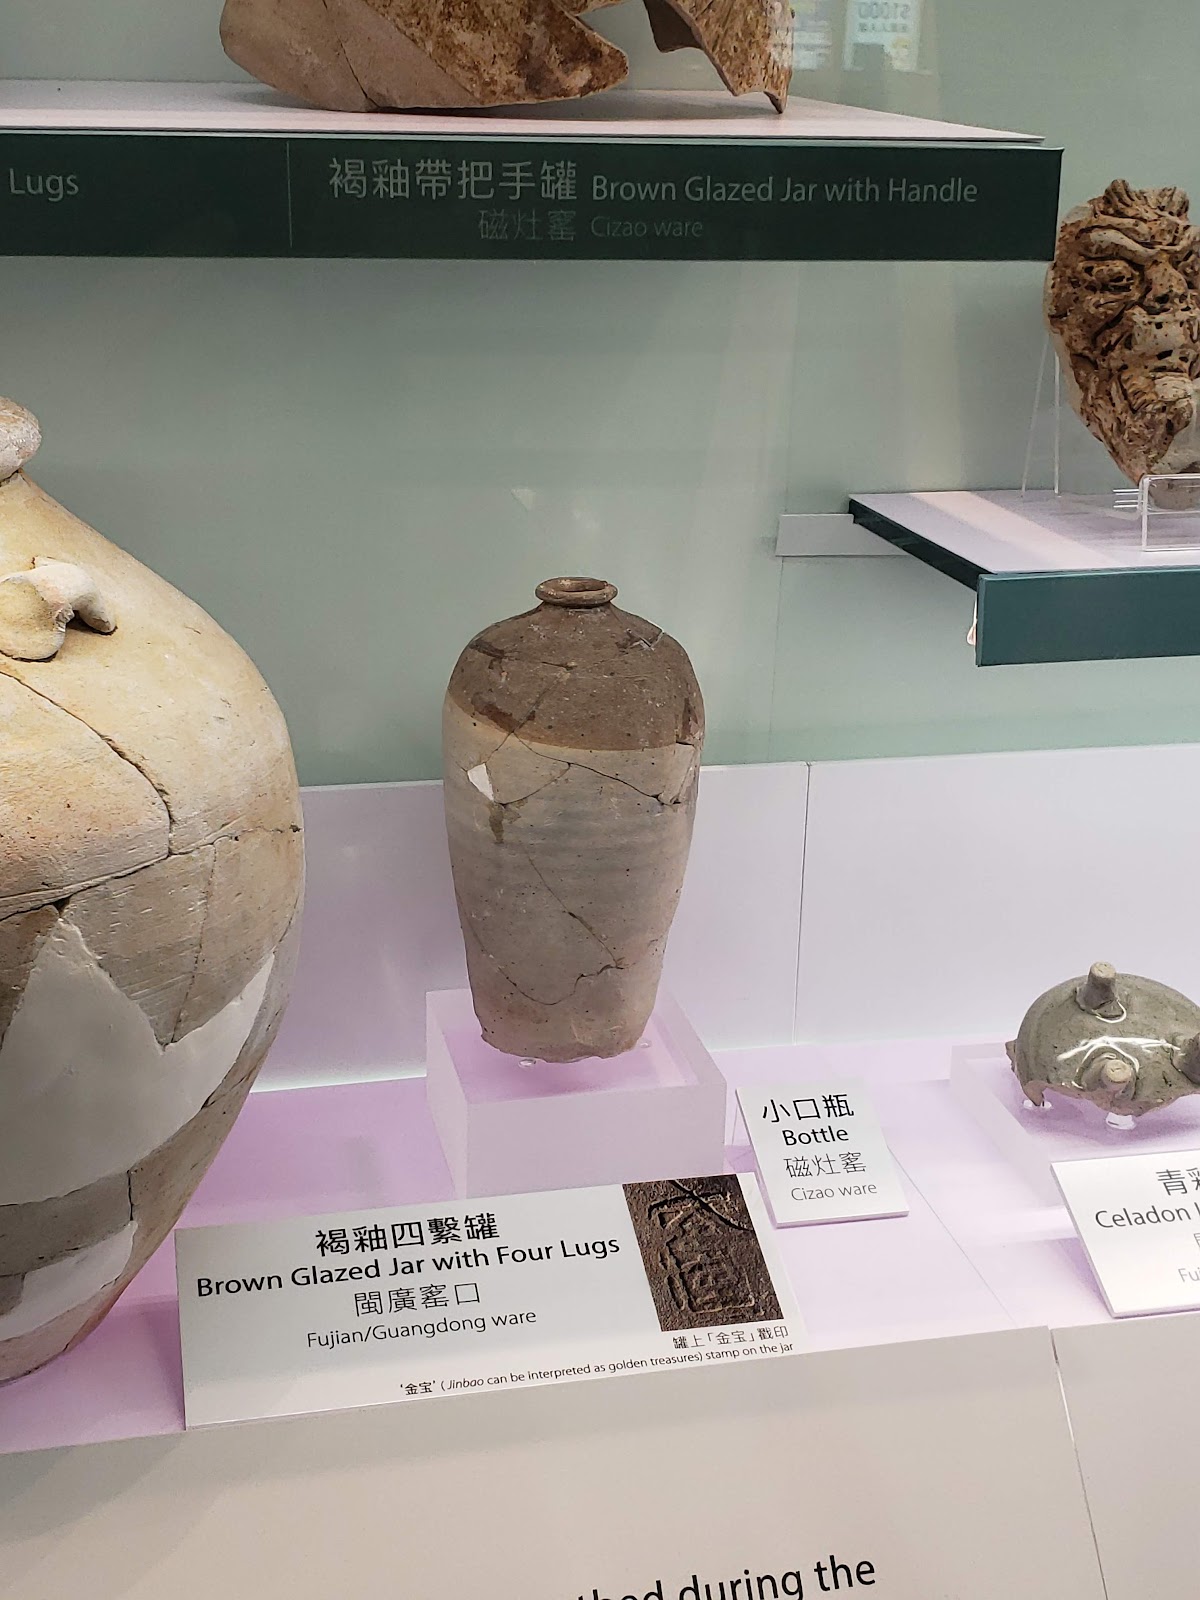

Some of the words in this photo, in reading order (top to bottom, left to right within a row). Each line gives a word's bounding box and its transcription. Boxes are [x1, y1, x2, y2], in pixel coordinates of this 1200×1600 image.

[9, 168, 79, 201] Lugs
[329, 157, 577, 200] 褐釉帶把手罐
[592, 176, 676, 201] Brown
[685, 176, 774, 201] Glazed
[780, 178, 817, 202] Jar
[825, 177, 880, 201] with
[889, 178, 978, 202] Handle
[591, 216, 648, 238] Cizao
[653, 221, 703, 238] ware
[762, 1094, 855, 1123] 小口瓶
[782, 1126, 849, 1146] Bottle
[791, 1187, 835, 1201] Cizao
[838, 1184, 877, 1198] ware
[1095, 1205, 1192, 1228] Celadon
[315, 1212, 500, 1257] 褐釉四繫罐
[197, 1274, 283, 1297] Brown
[291, 1259, 381, 1286] Glazed
[388, 1257, 425, 1277] Jar
[432, 1248, 490, 1271] with
[496, 1245, 553, 1265] Four
[560, 1238, 620, 1259] Lugs
[307, 1317, 486, 1349] Fujian/Guangdong
[491, 1311, 537, 1326] ware
[487, 1375, 508, 1385] can
[510, 1372, 525, 1382] be
[528, 1364, 591, 1379] interpreted
[594, 1364, 606, 1373] as
[608, 1358, 648, 1374] golden
[650, 1352, 703, 1367] treasures)
[706, 1350, 740, 1361] stamp
[742, 1347, 758, 1356] on
[759, 1344, 778, 1354] the
[780, 1342, 794, 1354] jar
[679, 1569, 804, 1600] during
[814, 1555, 876, 1592] the
